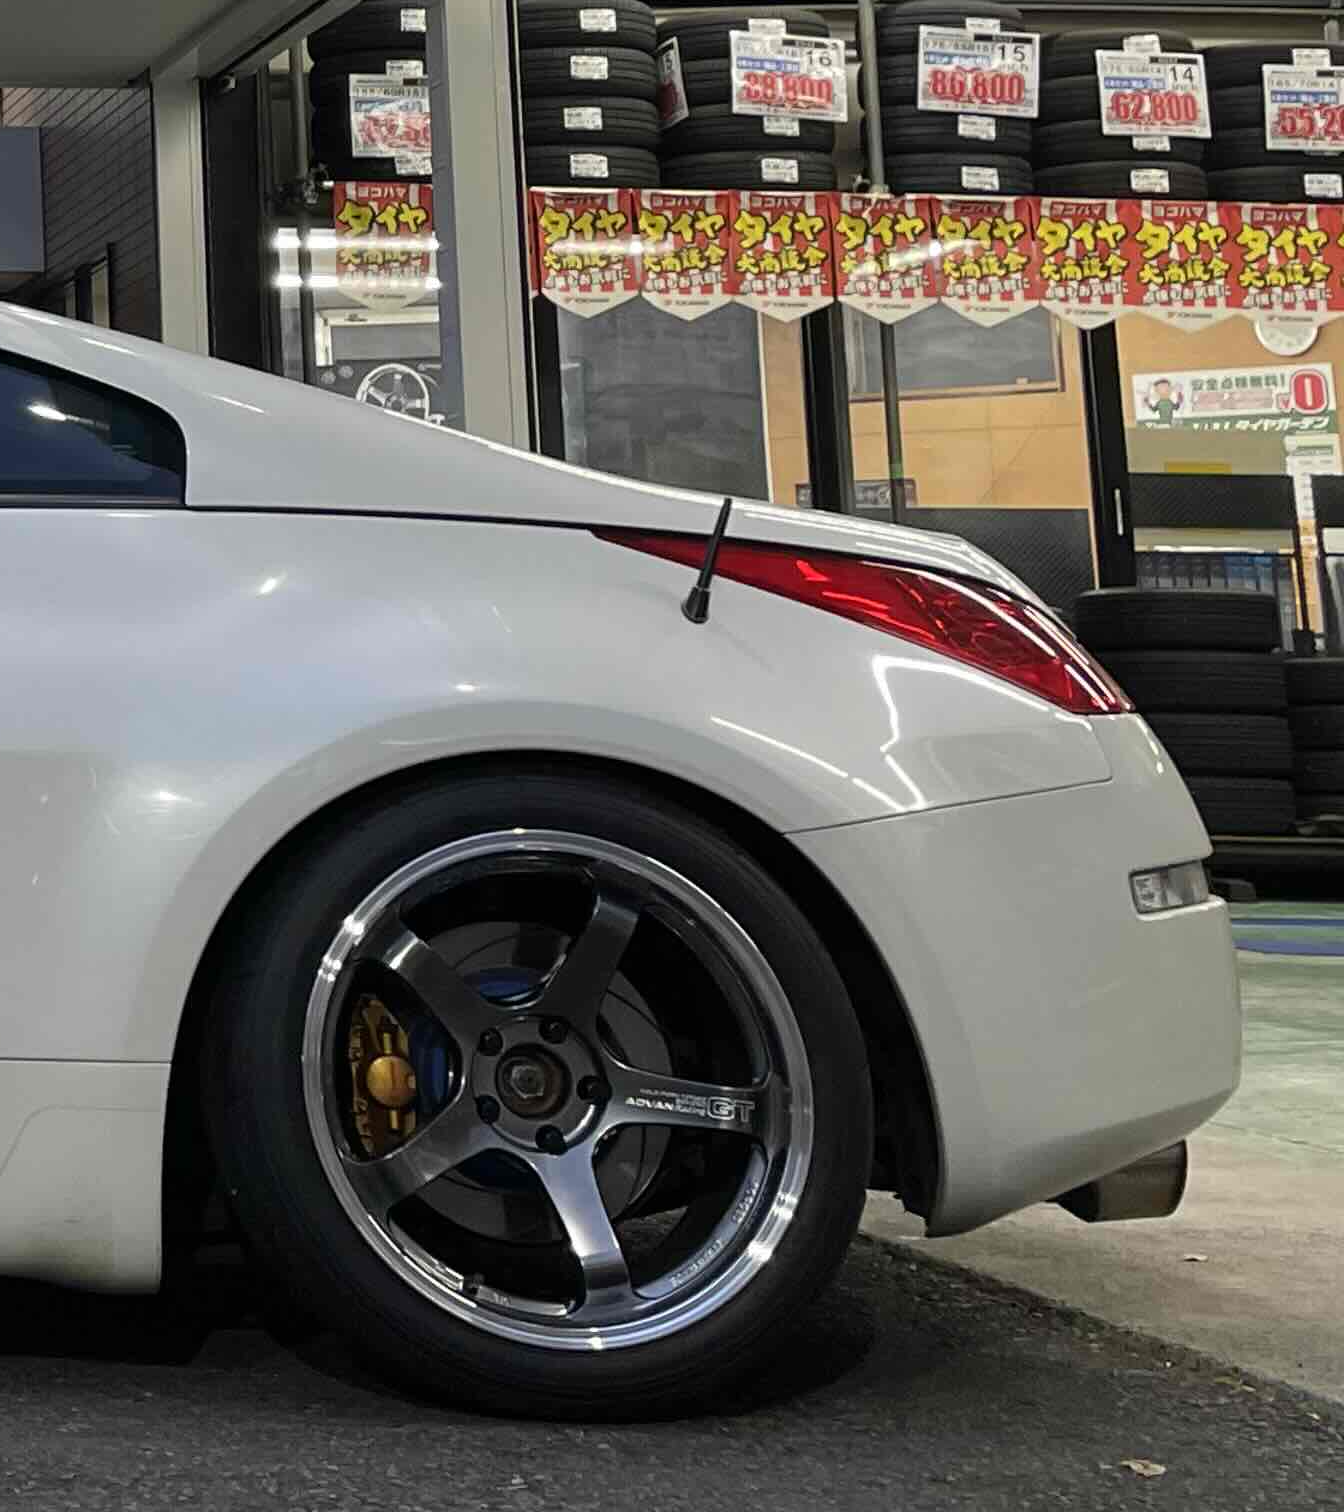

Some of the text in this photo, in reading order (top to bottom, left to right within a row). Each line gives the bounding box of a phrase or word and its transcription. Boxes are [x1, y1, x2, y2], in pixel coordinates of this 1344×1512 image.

[998, 44, 1025, 62] 15
[1169, 66, 1195, 83] 14
[336, 199, 429, 237] タイヤ
[540, 206, 627, 245] タイヤ
[640, 208, 726, 243] タイヤ
[733, 208, 826, 249] タイヤ
[835, 212, 926, 250] タイヤ
[936, 214, 1026, 250] タイヤ
[1036, 216, 1128, 256] タイヤ
[1136, 218, 1228, 259] タイヤ
[1235, 222, 1329, 263] タイヤ
[625, 1096, 673, 1111] ADVAN
[707, 1096, 756, 1123] GT
